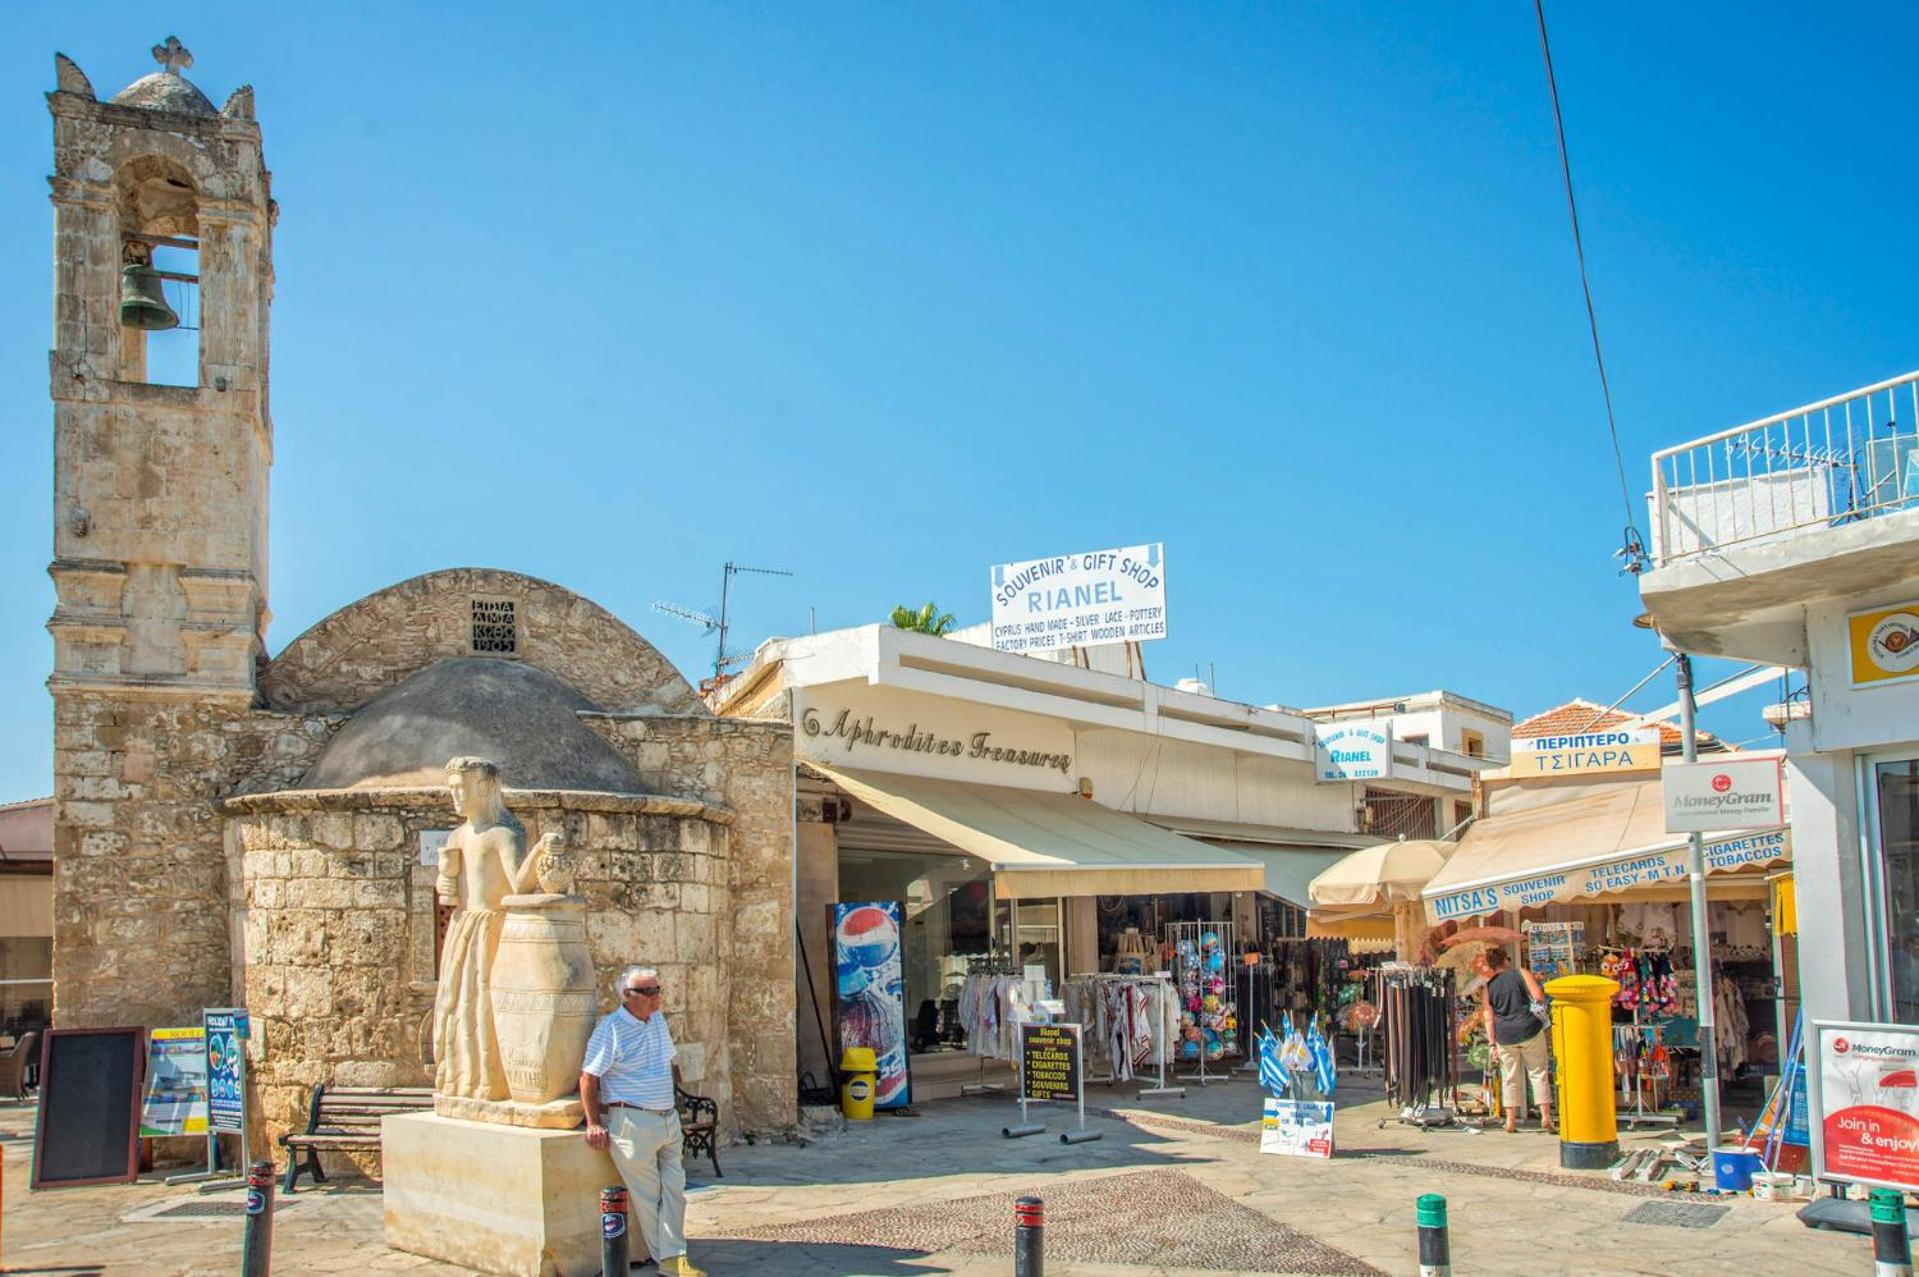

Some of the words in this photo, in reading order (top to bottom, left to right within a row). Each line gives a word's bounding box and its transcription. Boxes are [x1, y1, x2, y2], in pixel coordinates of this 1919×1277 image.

[997, 558, 1064, 606] SOUVENIR
[1070, 558, 1077, 570] &
[1083, 554, 1116, 571] GIFT
[1120, 558, 1159, 590] SHOP
[1028, 581, 1122, 613] RIANEL
[995, 624, 1021, 638] CYPRUS
[1025, 621, 1045, 634] HAND
[1047, 618, 1067, 631] MADE
[1075, 614, 1099, 627] SILVER
[1105, 611, 1122, 624] LACE
[1129, 606, 1162, 621] POTTERY
[996, 638, 1027, 650] FACTORY
[1030, 634, 1055, 648] PRICES
[1091, 625, 1125, 640] WOODEN
[1129, 621, 1164, 636] ARTICLES
[803, 708, 964, 756] Aphrodites
[969, 731, 1074, 774] Treasures
[1536, 732, 1629, 750] ΠΕΡΙΠΤΕΡΟ
[1331, 750, 1371, 763] RIANEL
[1535, 750, 1633, 771] ΤΣΙΓΑΡΑ
[1674, 792, 1771, 808] MoneyGram
[1702, 832, 1784, 857] CIGARETTES
[1708, 846, 1782, 867] TOBACCOS
[1591, 856, 1666, 878] TELECARDS
[1503, 875, 1566, 896] SOUVENIR
[1585, 880, 1603, 892] SO
[1435, 888, 1498, 916] NITSA'S
[1520, 890, 1555, 905] SHOP
[1032, 1051, 1068, 1060] TELECARDS
[1031, 1061, 1071, 1070] CIGARETTES
[1032, 1070, 1066, 1080] TOBACCOS
[1032, 1090, 1051, 1098] GIFTS
[1837, 1116, 1866, 1131] Join
[1868, 1119, 1881, 1133] in
[1861, 1132, 1873, 1145] &
